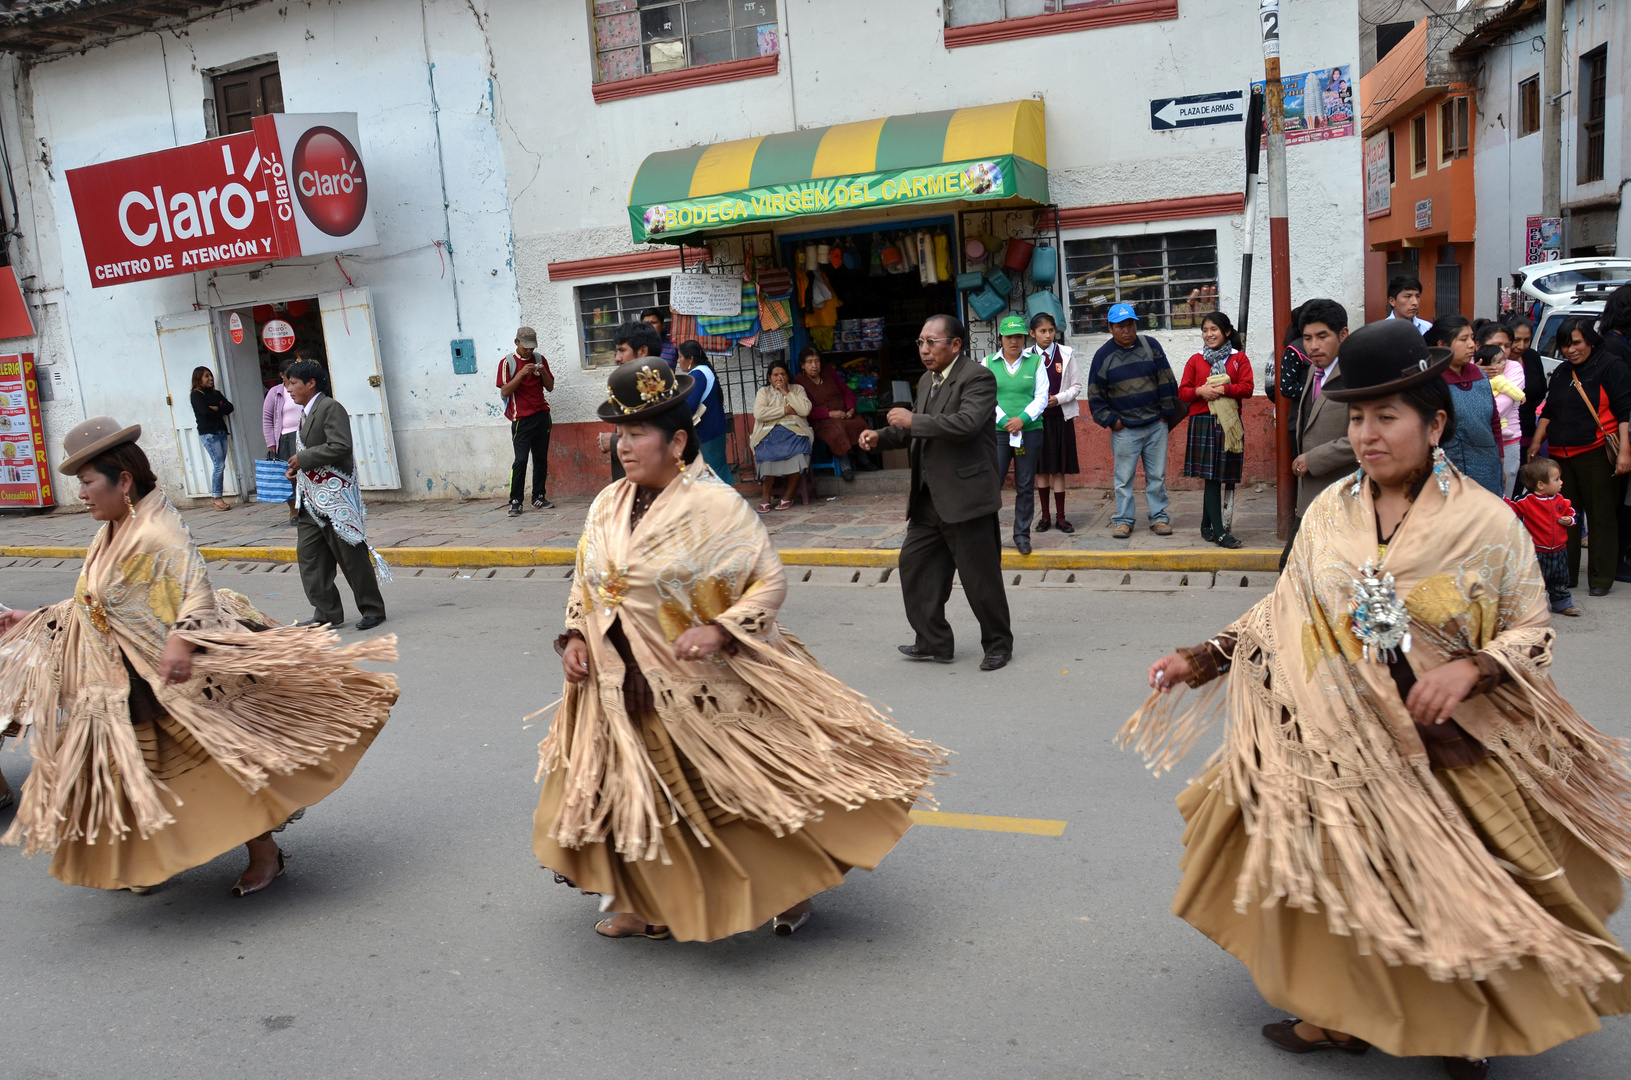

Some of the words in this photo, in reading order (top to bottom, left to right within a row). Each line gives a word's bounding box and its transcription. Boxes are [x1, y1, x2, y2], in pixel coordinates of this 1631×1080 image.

[1264, 12, 1279, 40] 2
[1180, 107, 1200, 116] PLAZA
[1201, 105, 1210, 114] DE
[1211, 103, 1234, 112] ARMAS
[271, 161, 292, 221] Claro
[299, 171, 354, 197] Claro
[665, 200, 747, 229] BODEGA
[750, 188, 829, 217] VIRGEN
[835, 184, 877, 206] DEL
[882, 170, 975, 199] CARMEN
[118, 182, 254, 247] Claro
[94, 257, 151, 280] CENTRO
[154, 254, 174, 271] DE
[181, 238, 258, 266] ATENCIÓN
[257, 237, 272, 253] Y
[24, 361, 50, 499] POLLERIA
